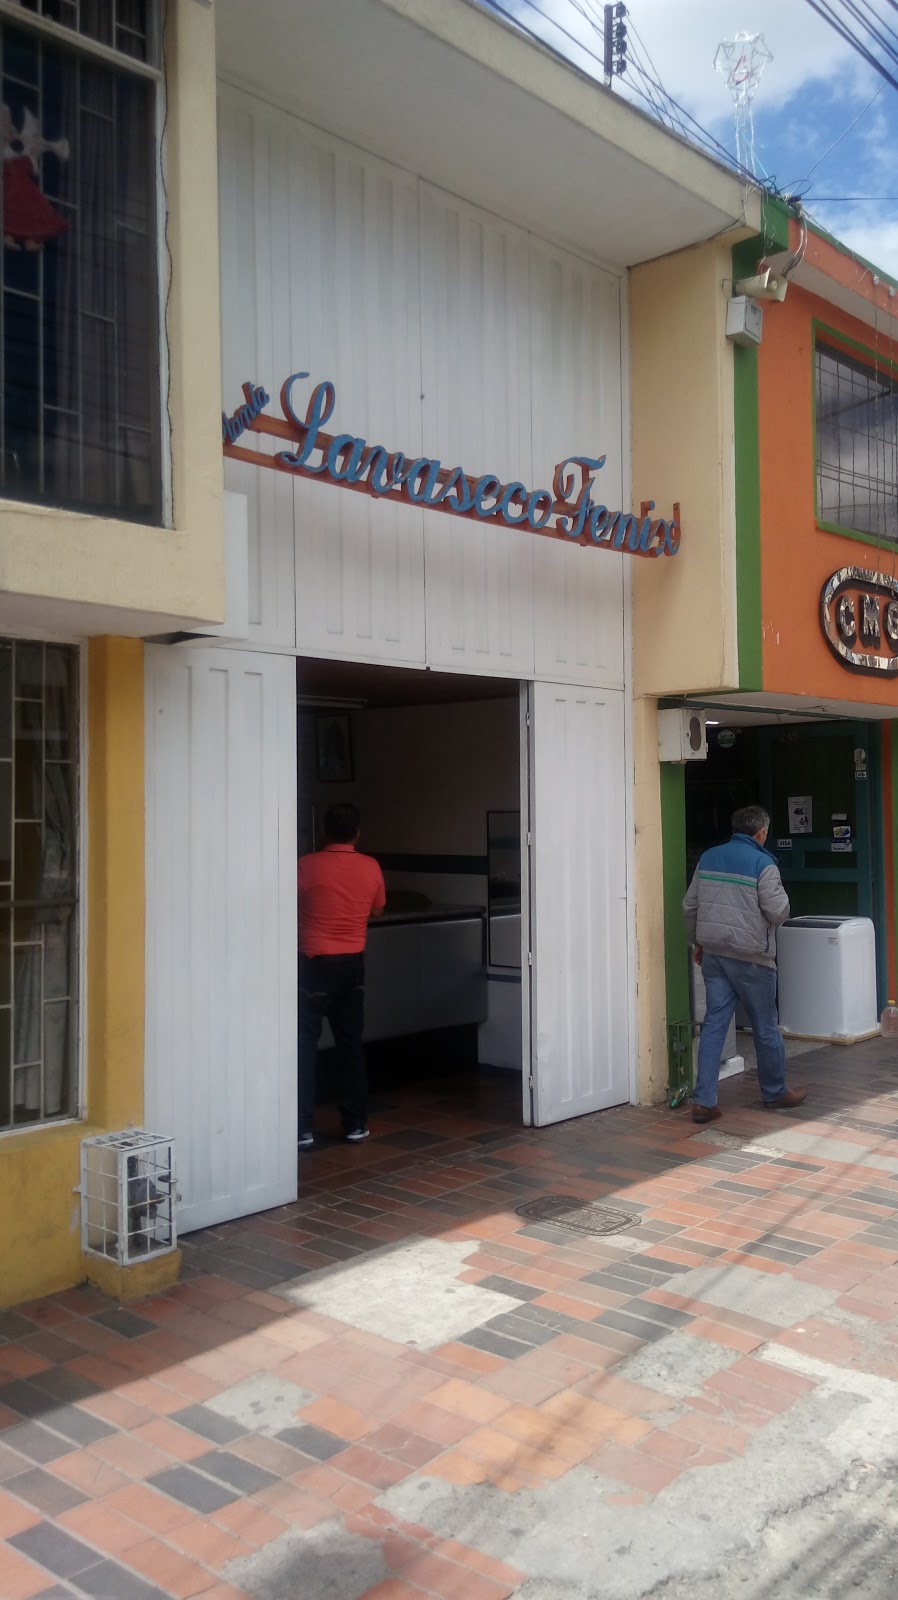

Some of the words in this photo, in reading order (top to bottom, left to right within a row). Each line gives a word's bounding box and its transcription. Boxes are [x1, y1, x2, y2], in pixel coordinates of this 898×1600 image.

[223, 381, 270, 443] lanta
[276, 371, 553, 529] Lavaseco
[554, 455, 681, 556] Fenix
